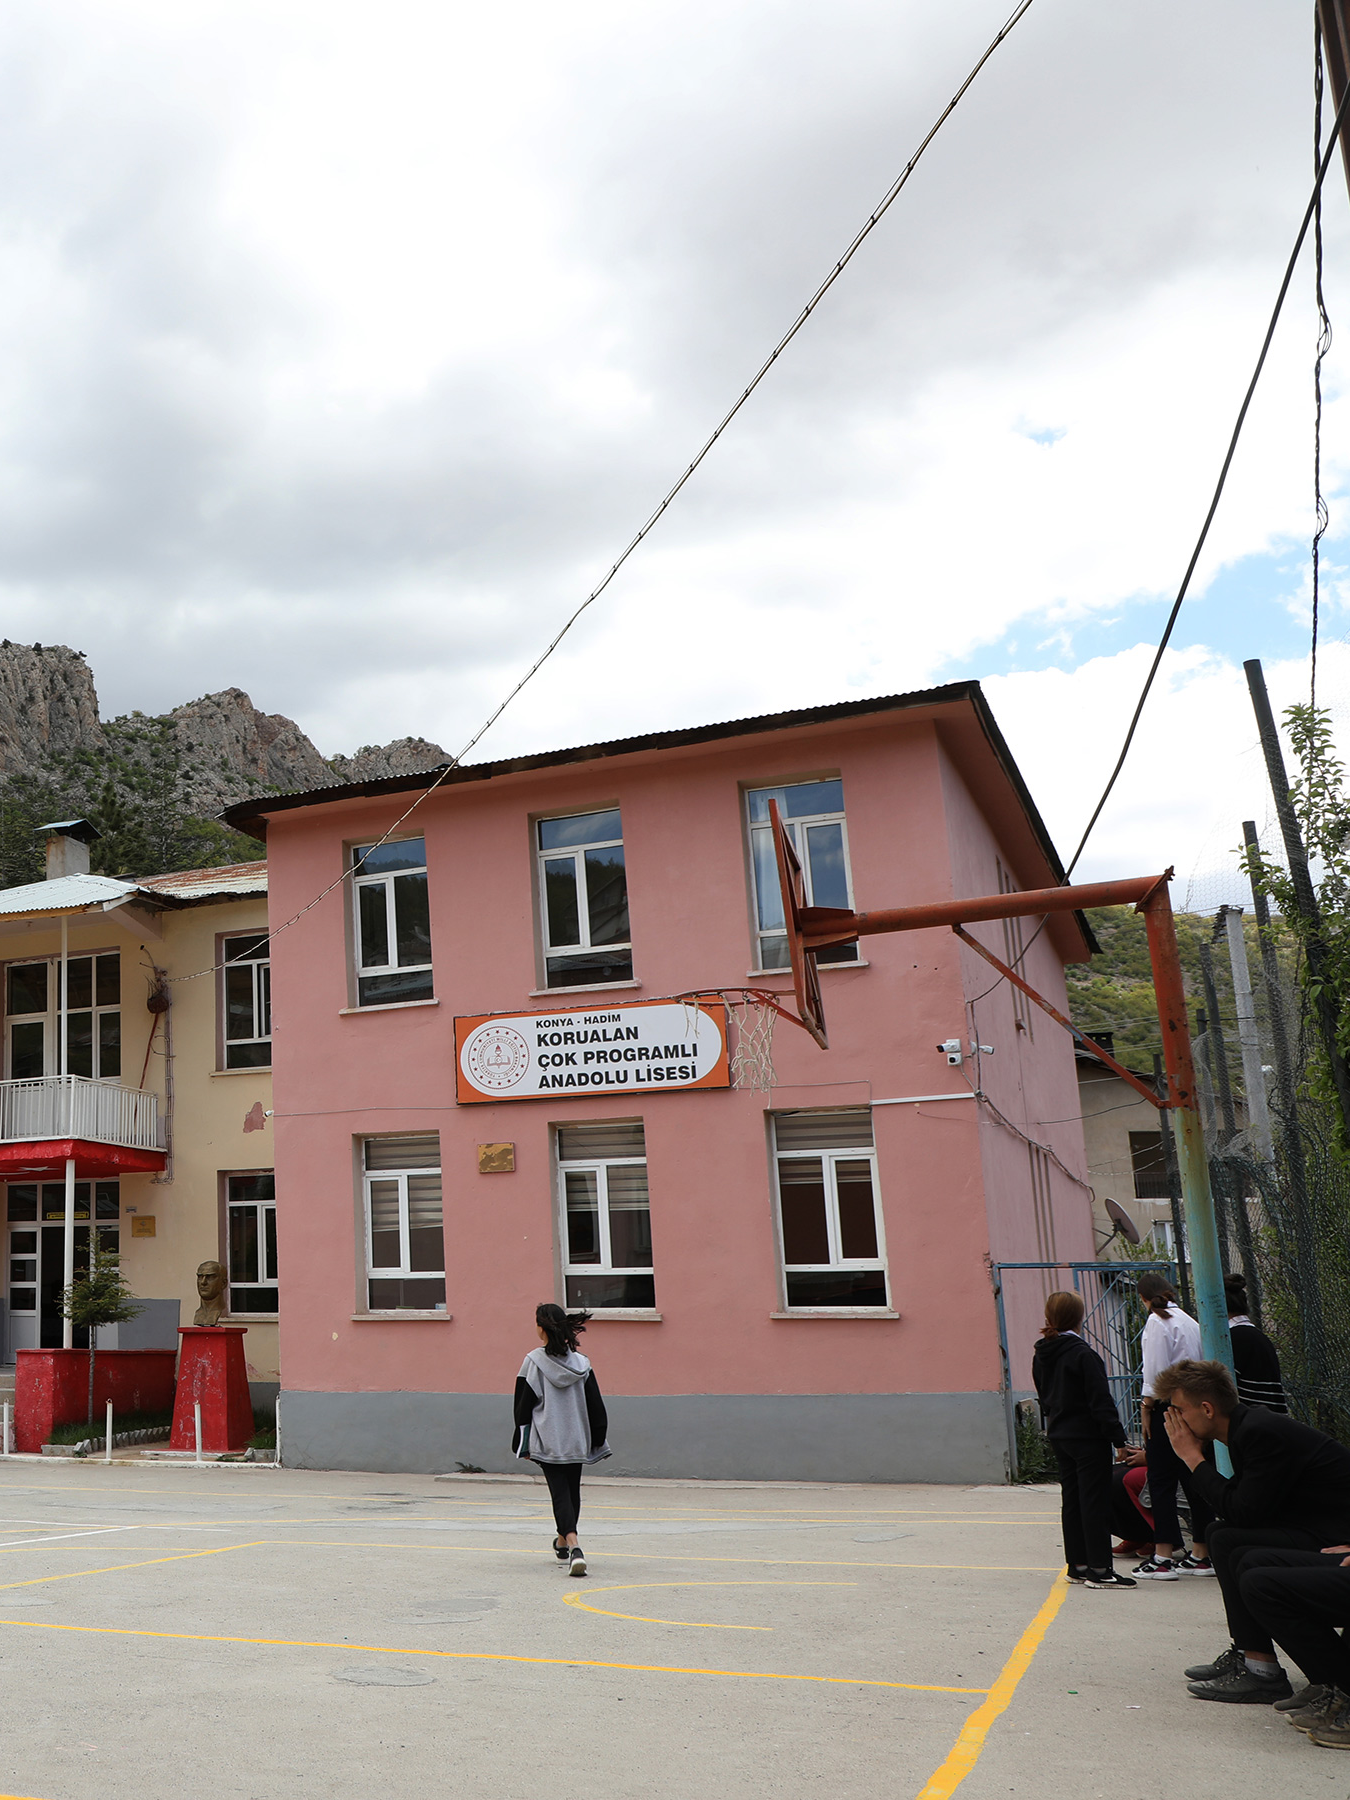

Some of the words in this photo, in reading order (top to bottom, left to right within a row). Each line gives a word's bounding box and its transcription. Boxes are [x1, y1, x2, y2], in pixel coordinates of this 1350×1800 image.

[535, 1018, 574, 1029] KONYA
[583, 1012, 621, 1025] HADİM
[537, 1026, 639, 1048] KORUALAN
[537, 1052, 578, 1072] ÇOK
[583, 1043, 698, 1065] PROGRAMLI
[538, 1069, 629, 1089] ANADOLU
[635, 1061, 697, 1082] LİSESİ
